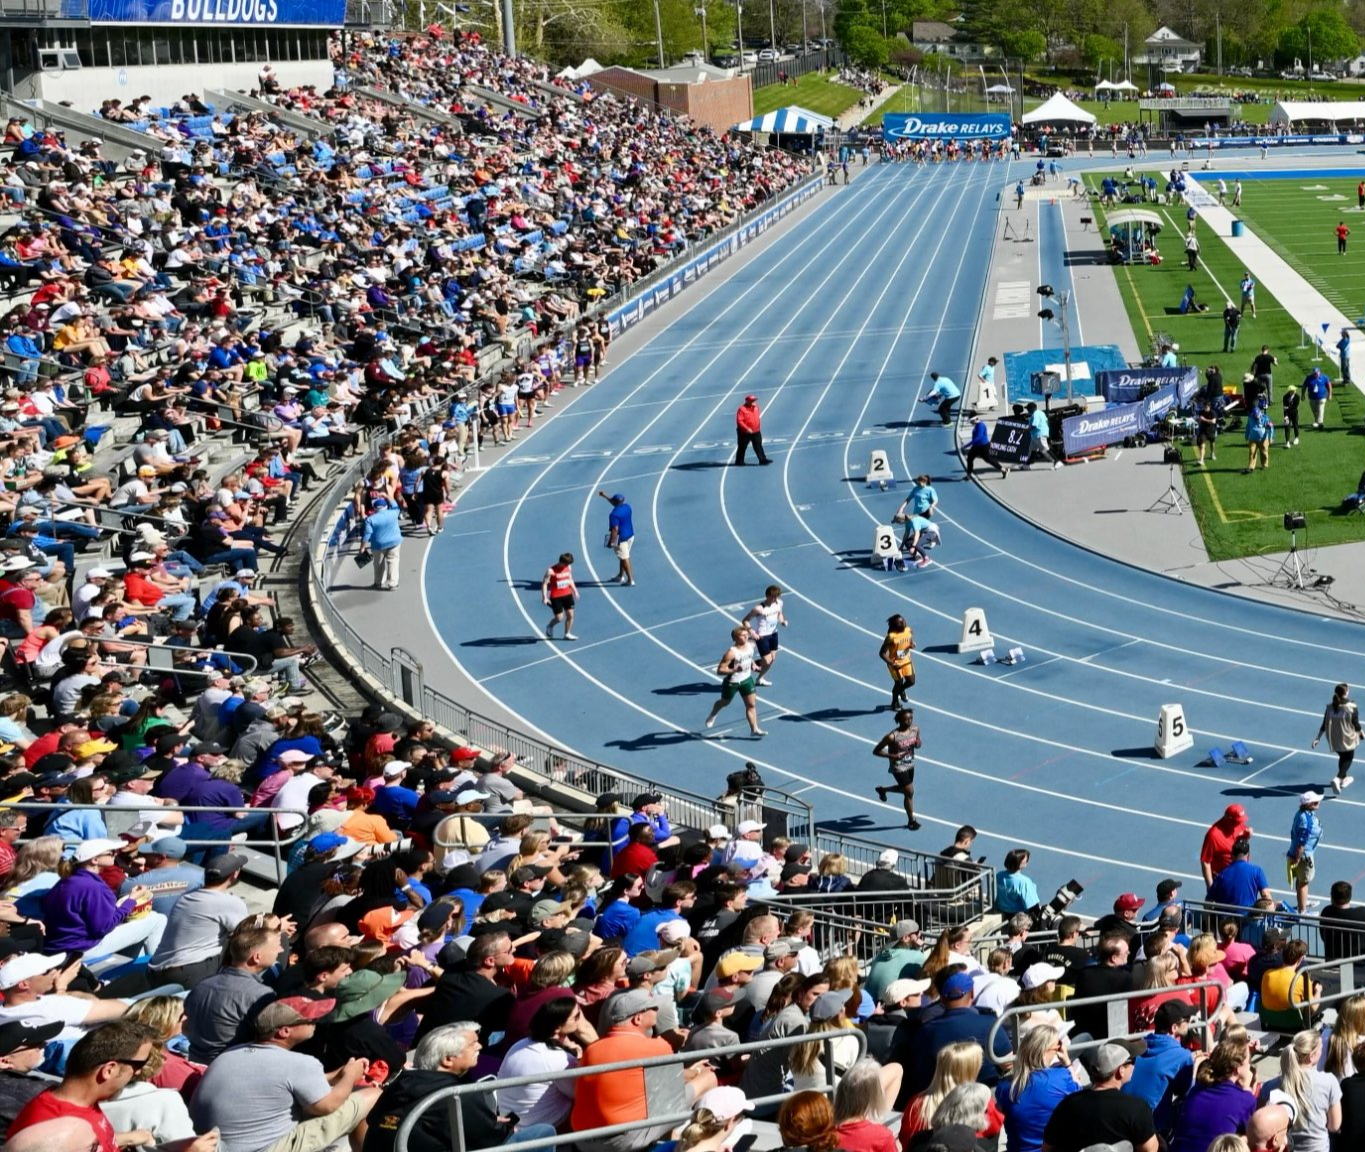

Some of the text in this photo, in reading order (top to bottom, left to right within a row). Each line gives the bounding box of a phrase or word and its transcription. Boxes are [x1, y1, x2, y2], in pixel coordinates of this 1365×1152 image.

[903, 117, 1004, 134] Drake RELAYS
[1119, 374, 1155, 386] Drake
[1156, 376, 1185, 386] RELAY
[983, 388, 991, 399] 1
[1078, 413, 1137, 435] Drake RELAYS
[873, 458, 884, 471] 2
[880, 534, 892, 550] 3
[968, 619, 982, 637] 4
[1172, 716, 1184, 738] 5
